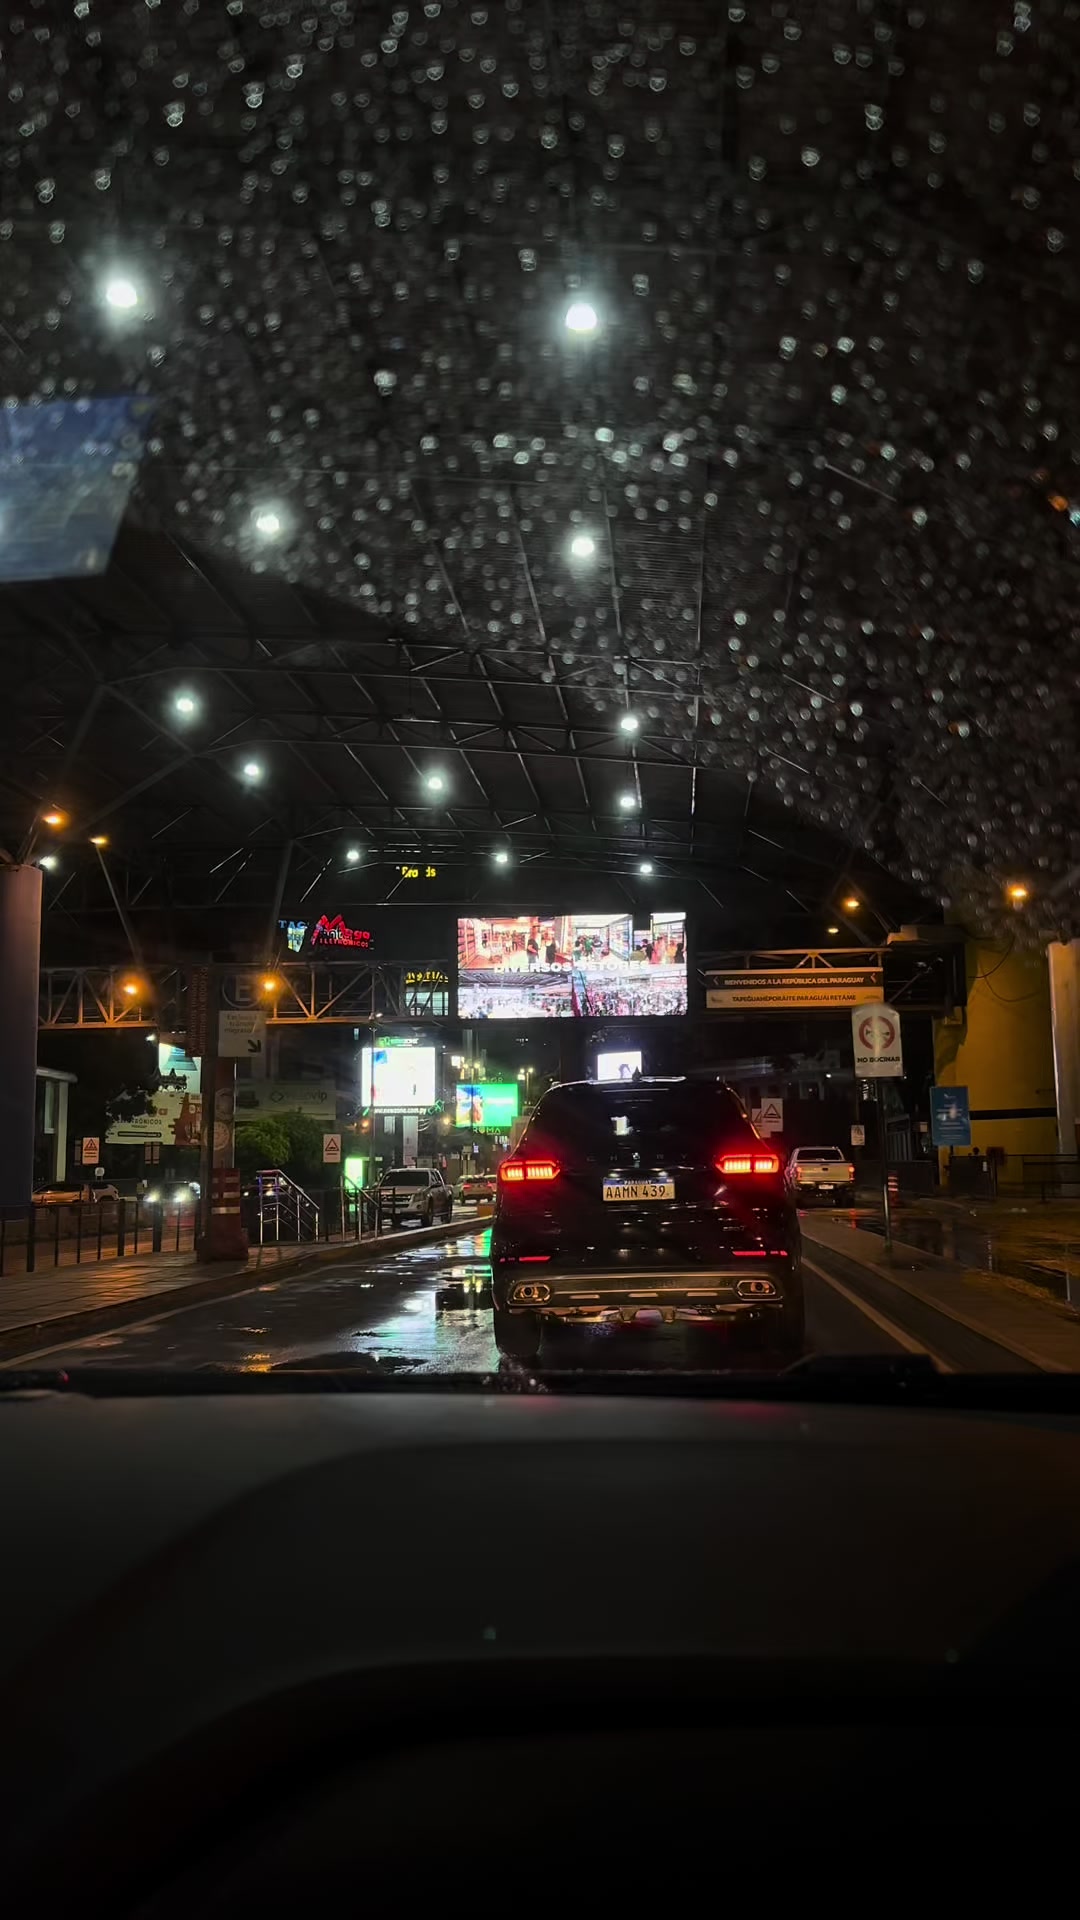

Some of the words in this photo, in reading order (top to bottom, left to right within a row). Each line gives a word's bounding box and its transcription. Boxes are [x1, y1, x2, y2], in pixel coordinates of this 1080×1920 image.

[401, 865, 436, 878] Brads
[494, 962, 572, 973] DIVERSOS
[576, 960, 650, 971] SETORES
[472, 1127, 501, 1135] ROMA
[606, 1186, 638, 1199] AAMN
[642, 1185, 666, 1198] 439
